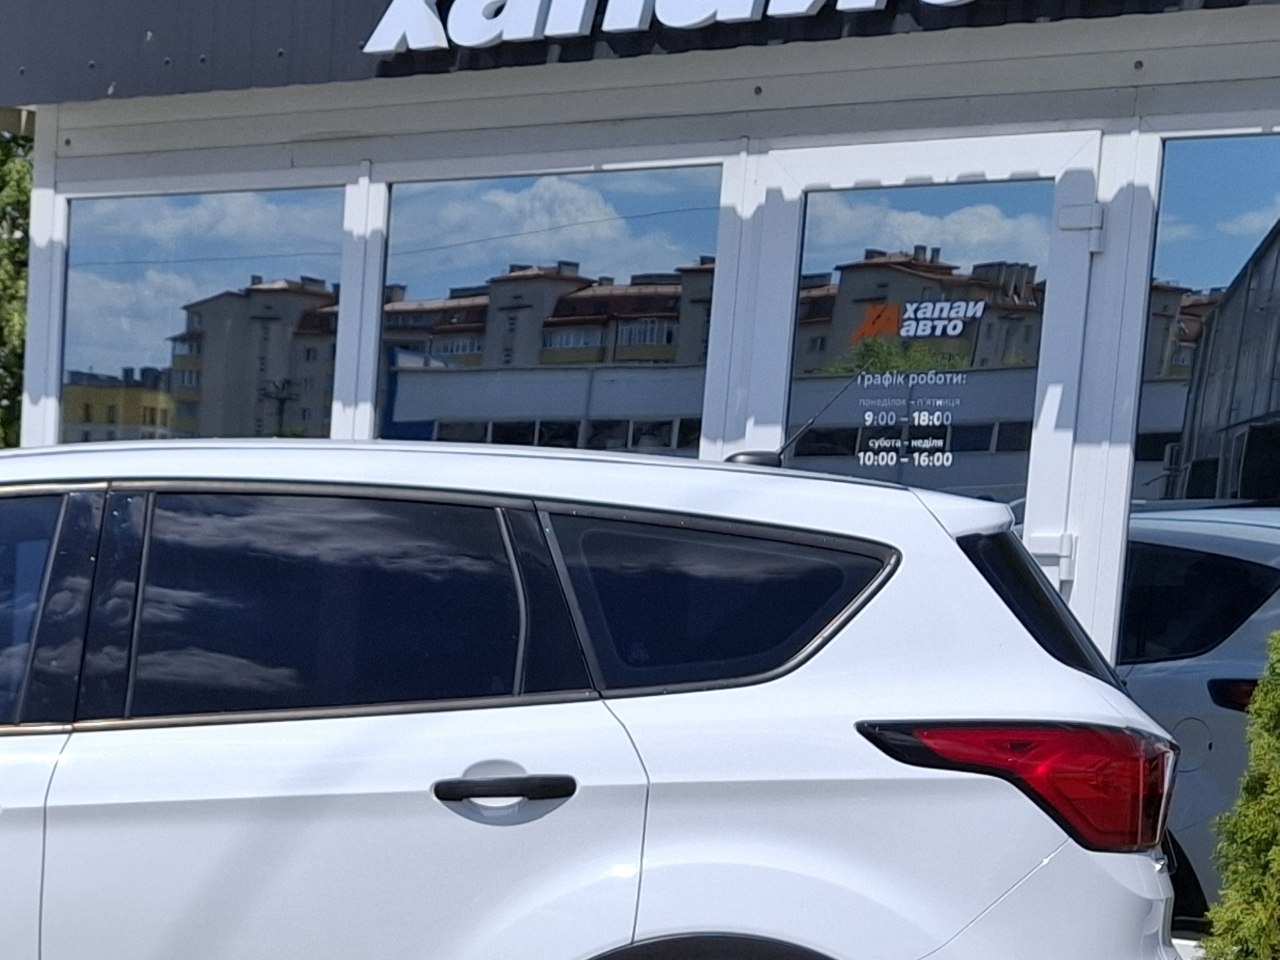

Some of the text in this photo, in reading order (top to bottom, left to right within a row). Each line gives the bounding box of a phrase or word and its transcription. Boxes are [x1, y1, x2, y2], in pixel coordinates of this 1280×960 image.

[900, 319, 964, 337] авто
[908, 370, 967, 388] роботи:
[864, 411, 896, 426] 9:00
[912, 411, 952, 426] 18:00
[868, 437, 902, 449] субота
[911, 437, 944, 449] неділя
[858, 451, 897, 466] 10:00
[913, 451, 953, 467] 16:00
